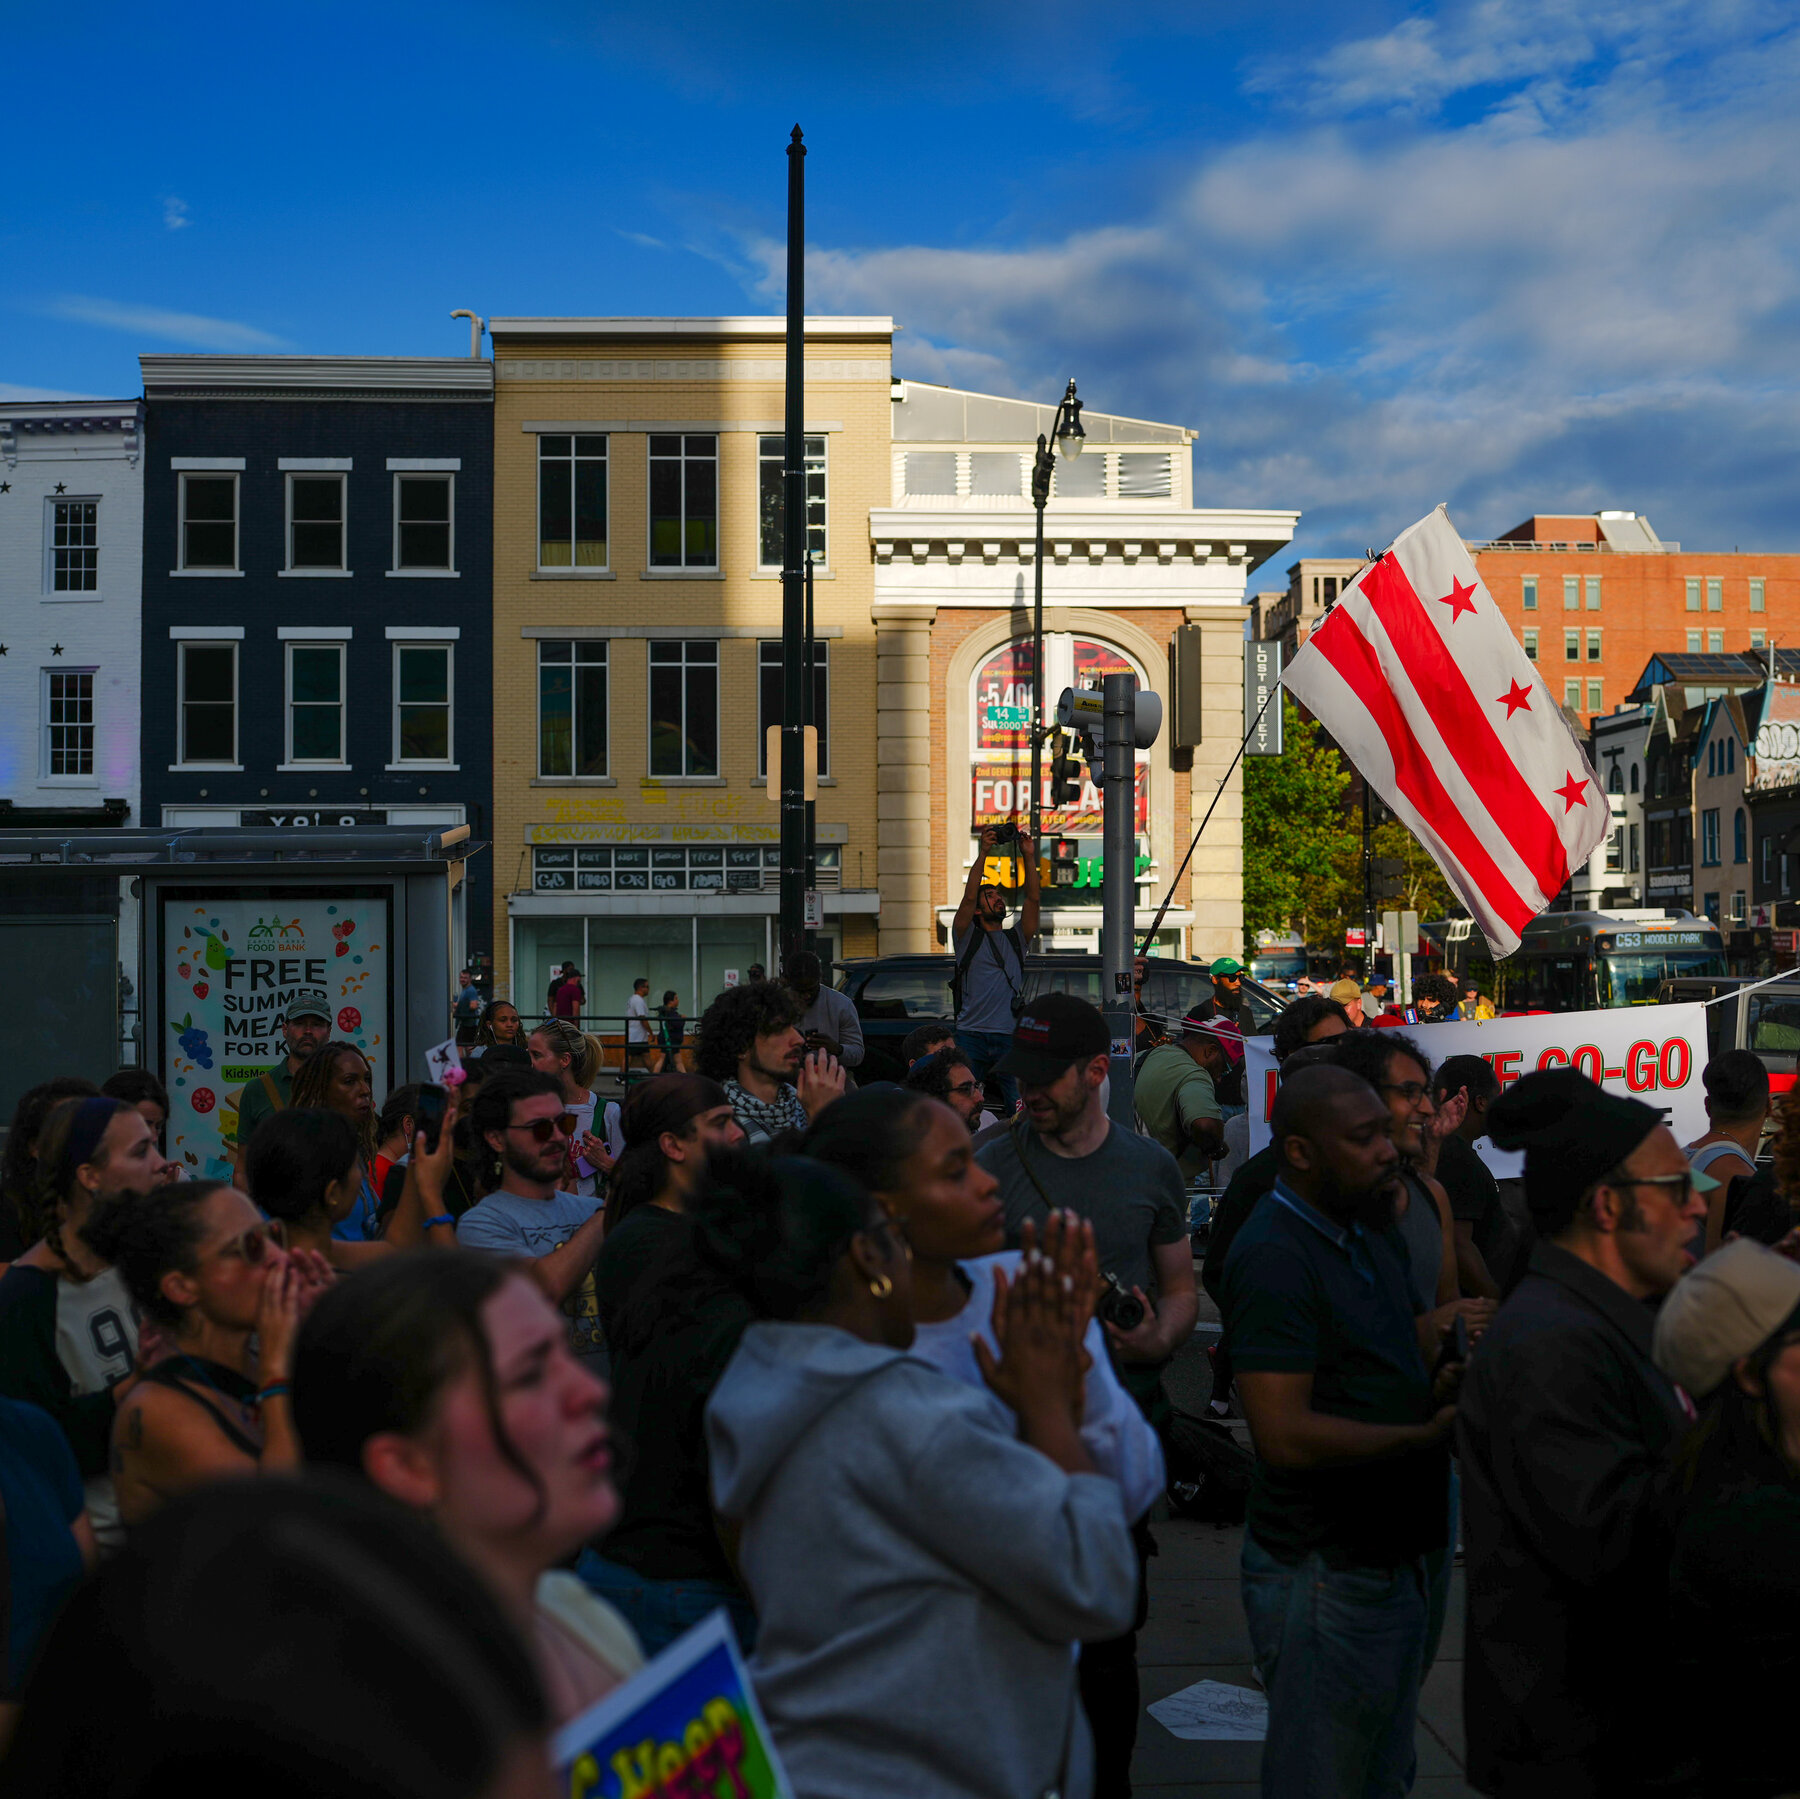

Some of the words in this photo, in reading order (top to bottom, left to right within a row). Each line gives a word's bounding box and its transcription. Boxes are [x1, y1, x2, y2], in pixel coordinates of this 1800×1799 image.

[1257, 644, 1268, 682] LOST
[995, 708, 1010, 720] 14
[1257, 686, 1268, 752] SOCIETY
[999, 721, 1021, 729] 2000
[976, 781, 1031, 811] FOR
[1616, 933, 1641, 947] C53
[1644, 934, 1679, 945] WOODLEY
[1680, 933, 1701, 944] PARK
[247, 943, 275, 952] FOOD
[278, 943, 306, 952] BANK
[225, 959, 328, 991] FREE
[224, 1042, 268, 1056] FOR
